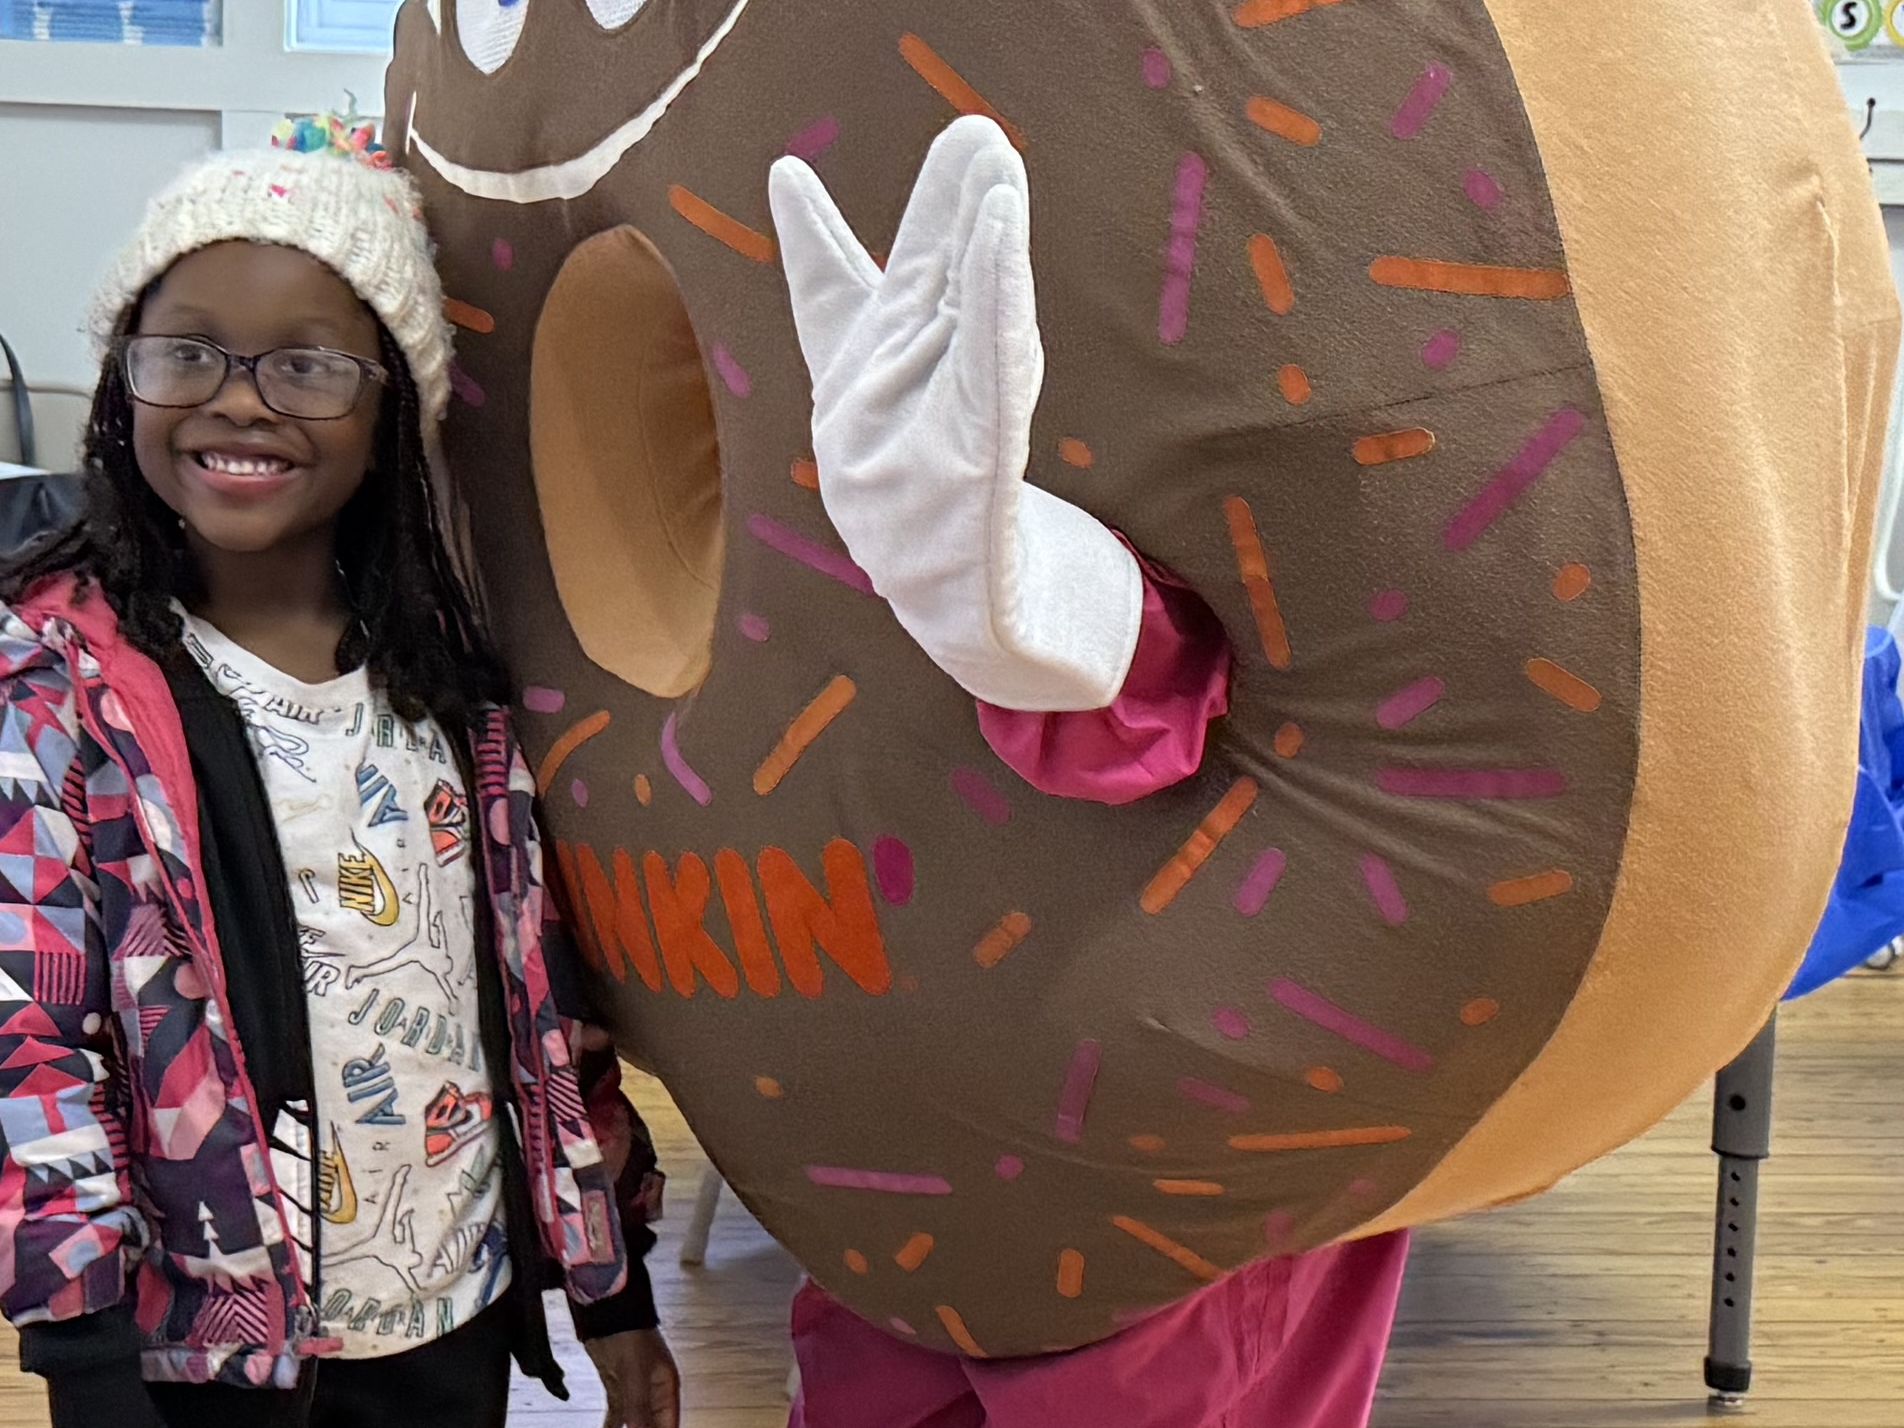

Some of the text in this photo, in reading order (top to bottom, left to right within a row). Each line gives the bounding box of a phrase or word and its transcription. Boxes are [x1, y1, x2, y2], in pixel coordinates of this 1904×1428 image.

[338, 853, 375, 916] NIKE
[556, 833, 916, 1000] NKIN'
[324, 1289, 454, 1338] ORDAN
